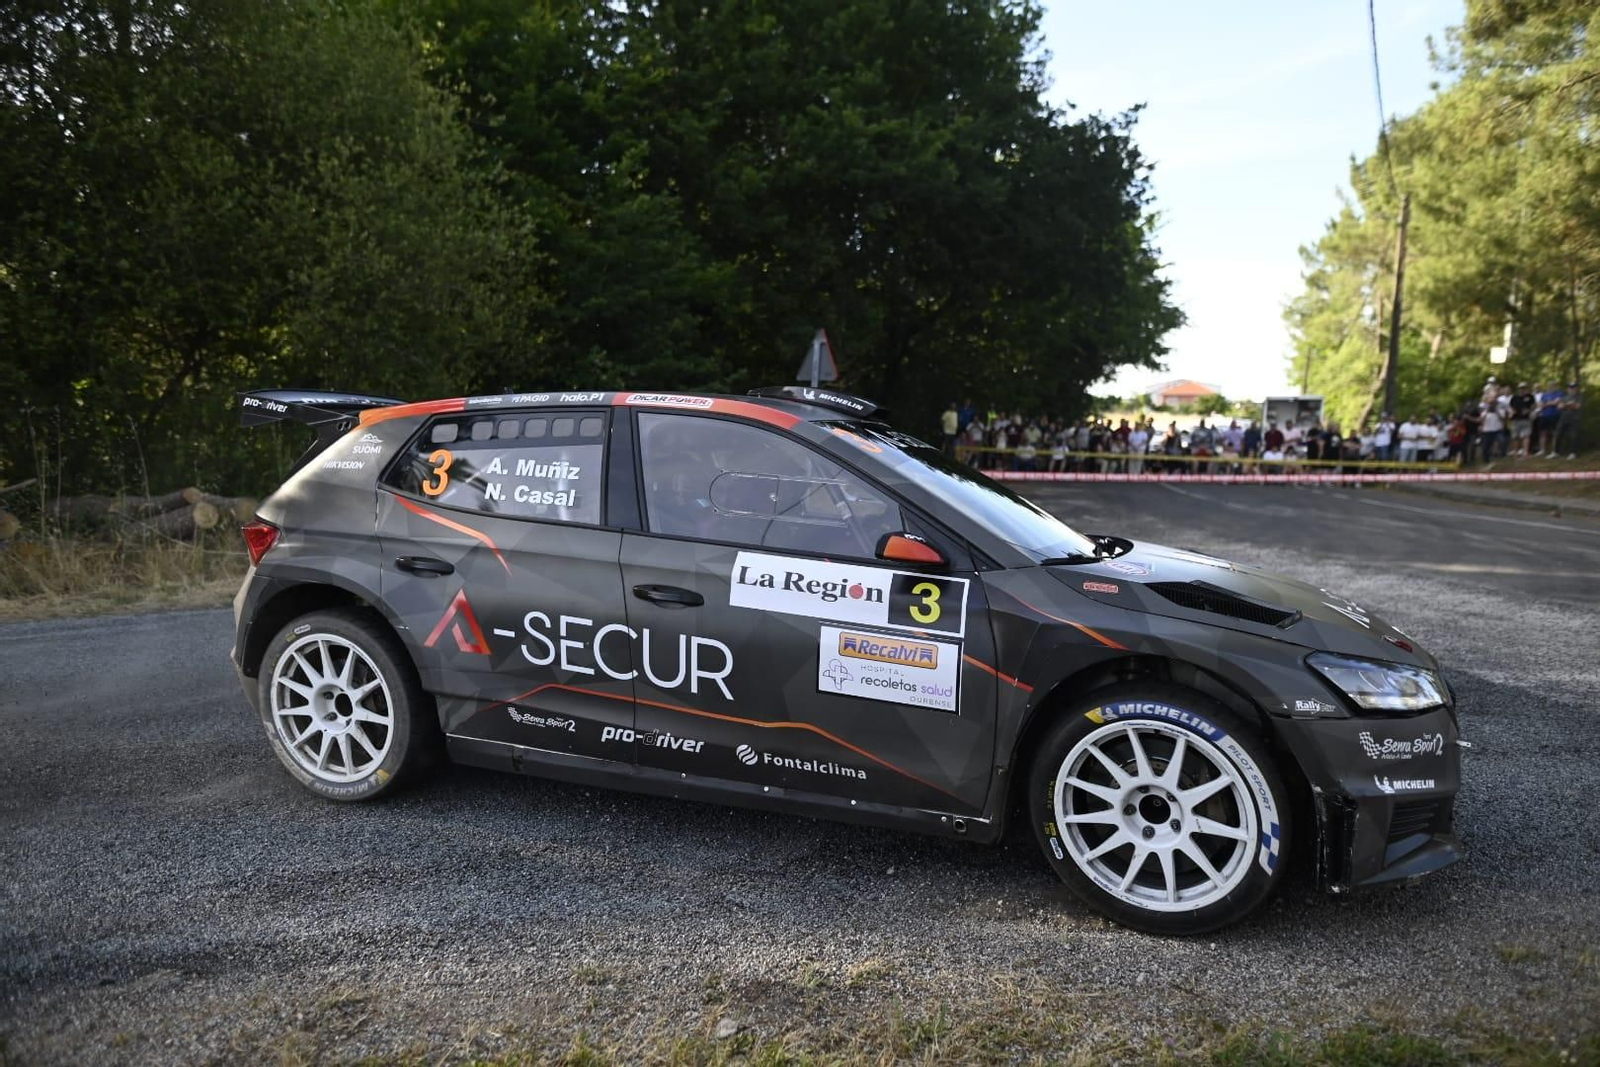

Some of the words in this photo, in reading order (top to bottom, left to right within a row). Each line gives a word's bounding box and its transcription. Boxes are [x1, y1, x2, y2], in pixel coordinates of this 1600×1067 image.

[243, 397, 288, 413] pro-river
[520, 394, 550, 403] PAGID
[819, 393, 864, 411] MICHELIN
[352, 445, 382, 454] SUOMI
[323, 461, 365, 469] HIKVISION
[422, 449, 453, 496] 3
[486, 456, 509, 475] A.
[515, 459, 580, 480] Muñiz
[484, 483, 505, 501] N.
[514, 485, 576, 507] Casal
[737, 565, 774, 588] La
[909, 582, 942, 624] 3
[858, 639, 918, 661] Recalvi
[861, 665, 905, 677] HOSPITAL
[861, 676, 917, 692] recoletas
[920, 683, 952, 697] salud
[910, 696, 952, 708] OURENSE
[1295, 700, 1320, 712] Rally
[1118, 703, 1216, 736] MICHELIN
[763, 752, 867, 780] Fontalclima
[1228, 744, 1254, 772] PILOT
[1251, 774, 1272, 812] SPORT
[1393, 779, 1435, 790] MICHELIN
